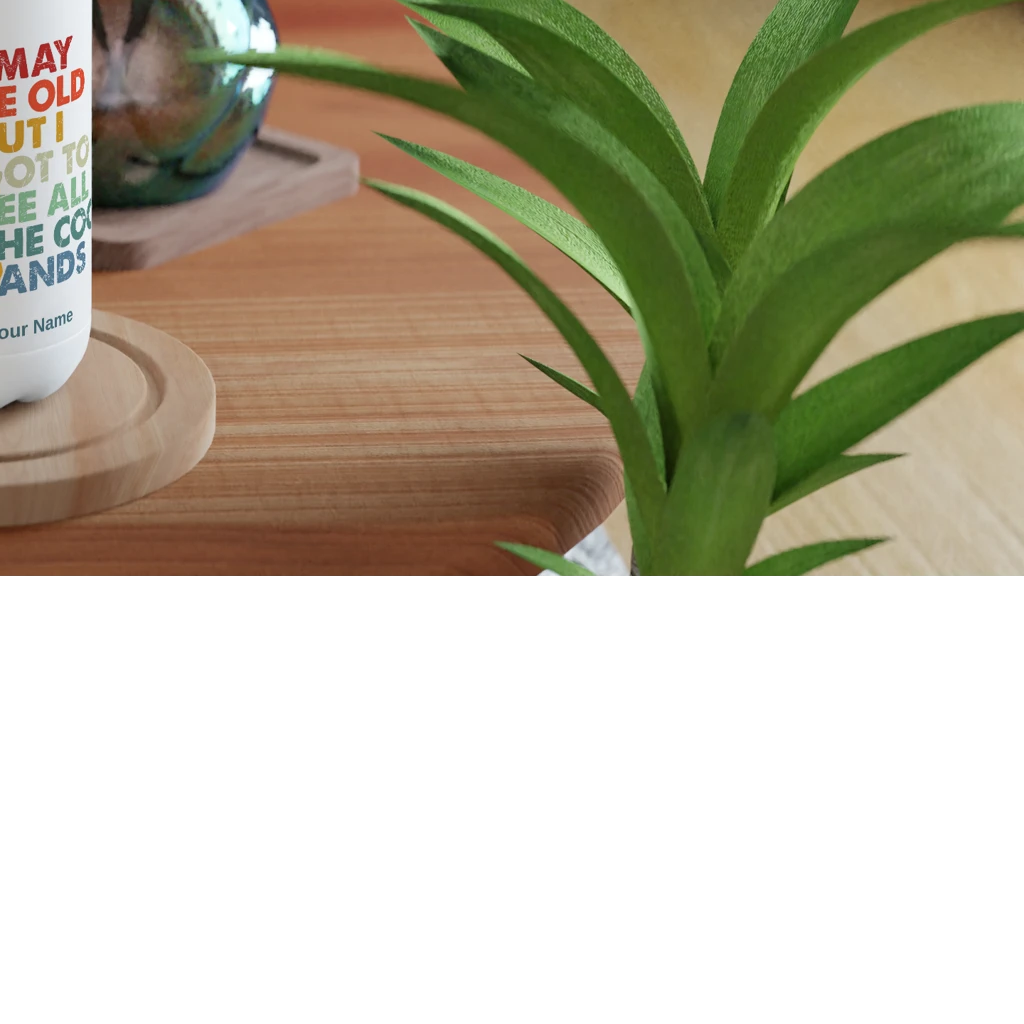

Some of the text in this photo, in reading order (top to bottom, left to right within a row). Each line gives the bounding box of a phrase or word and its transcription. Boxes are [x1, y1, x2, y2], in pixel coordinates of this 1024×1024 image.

[28, 68, 85, 112] OLD
[56, 111, 64, 143] I
[62, 134, 90, 175] TO
[47, 170, 89, 217] ALL
[33, 310, 74, 335] Name
